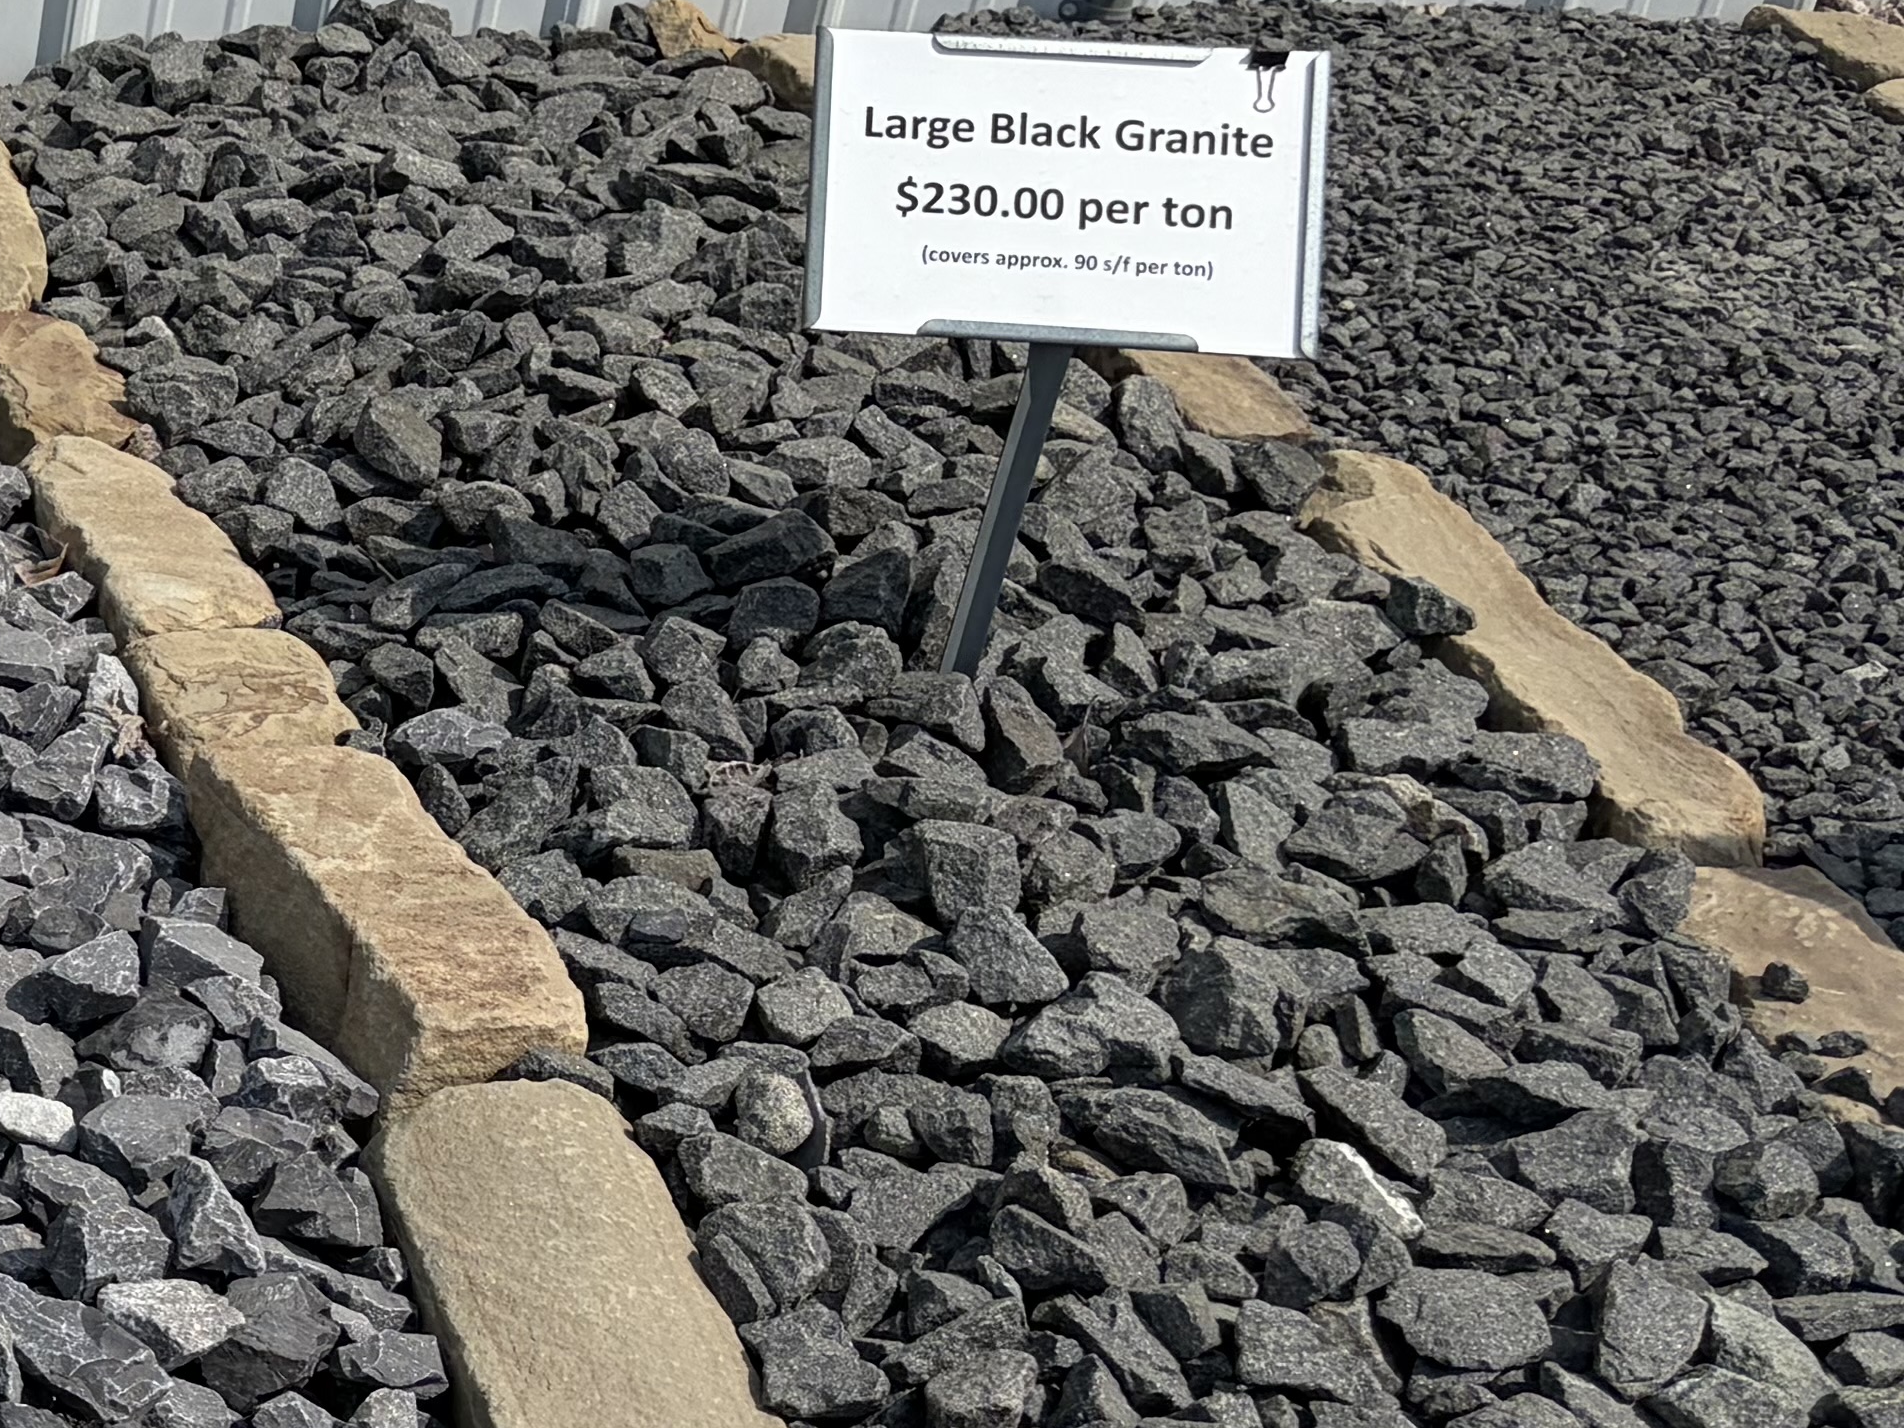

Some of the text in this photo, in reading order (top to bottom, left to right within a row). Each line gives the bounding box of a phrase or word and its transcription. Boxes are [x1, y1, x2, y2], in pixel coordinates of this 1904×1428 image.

[865, 106, 1273, 158] Large Black Granite
[896, 176, 1232, 230] $230.00 per ton
[922, 245, 1213, 281] (covers approx. 90 s/f per ton)
